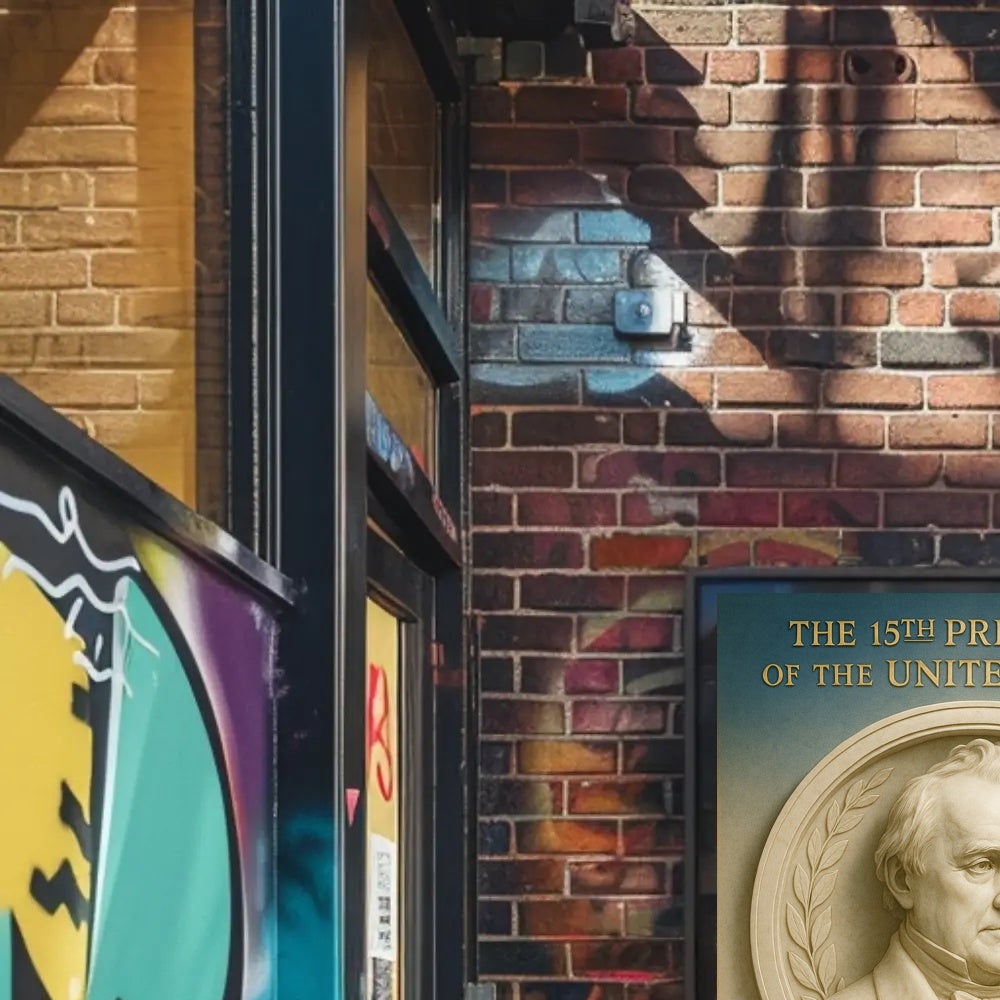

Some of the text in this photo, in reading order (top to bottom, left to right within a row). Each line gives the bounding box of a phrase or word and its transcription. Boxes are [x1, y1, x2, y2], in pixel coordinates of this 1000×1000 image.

[789, 619, 857, 647] THE
[871, 618, 936, 647] 15TH
[762, 663, 800, 687] OF
[813, 663, 873, 687] THE
